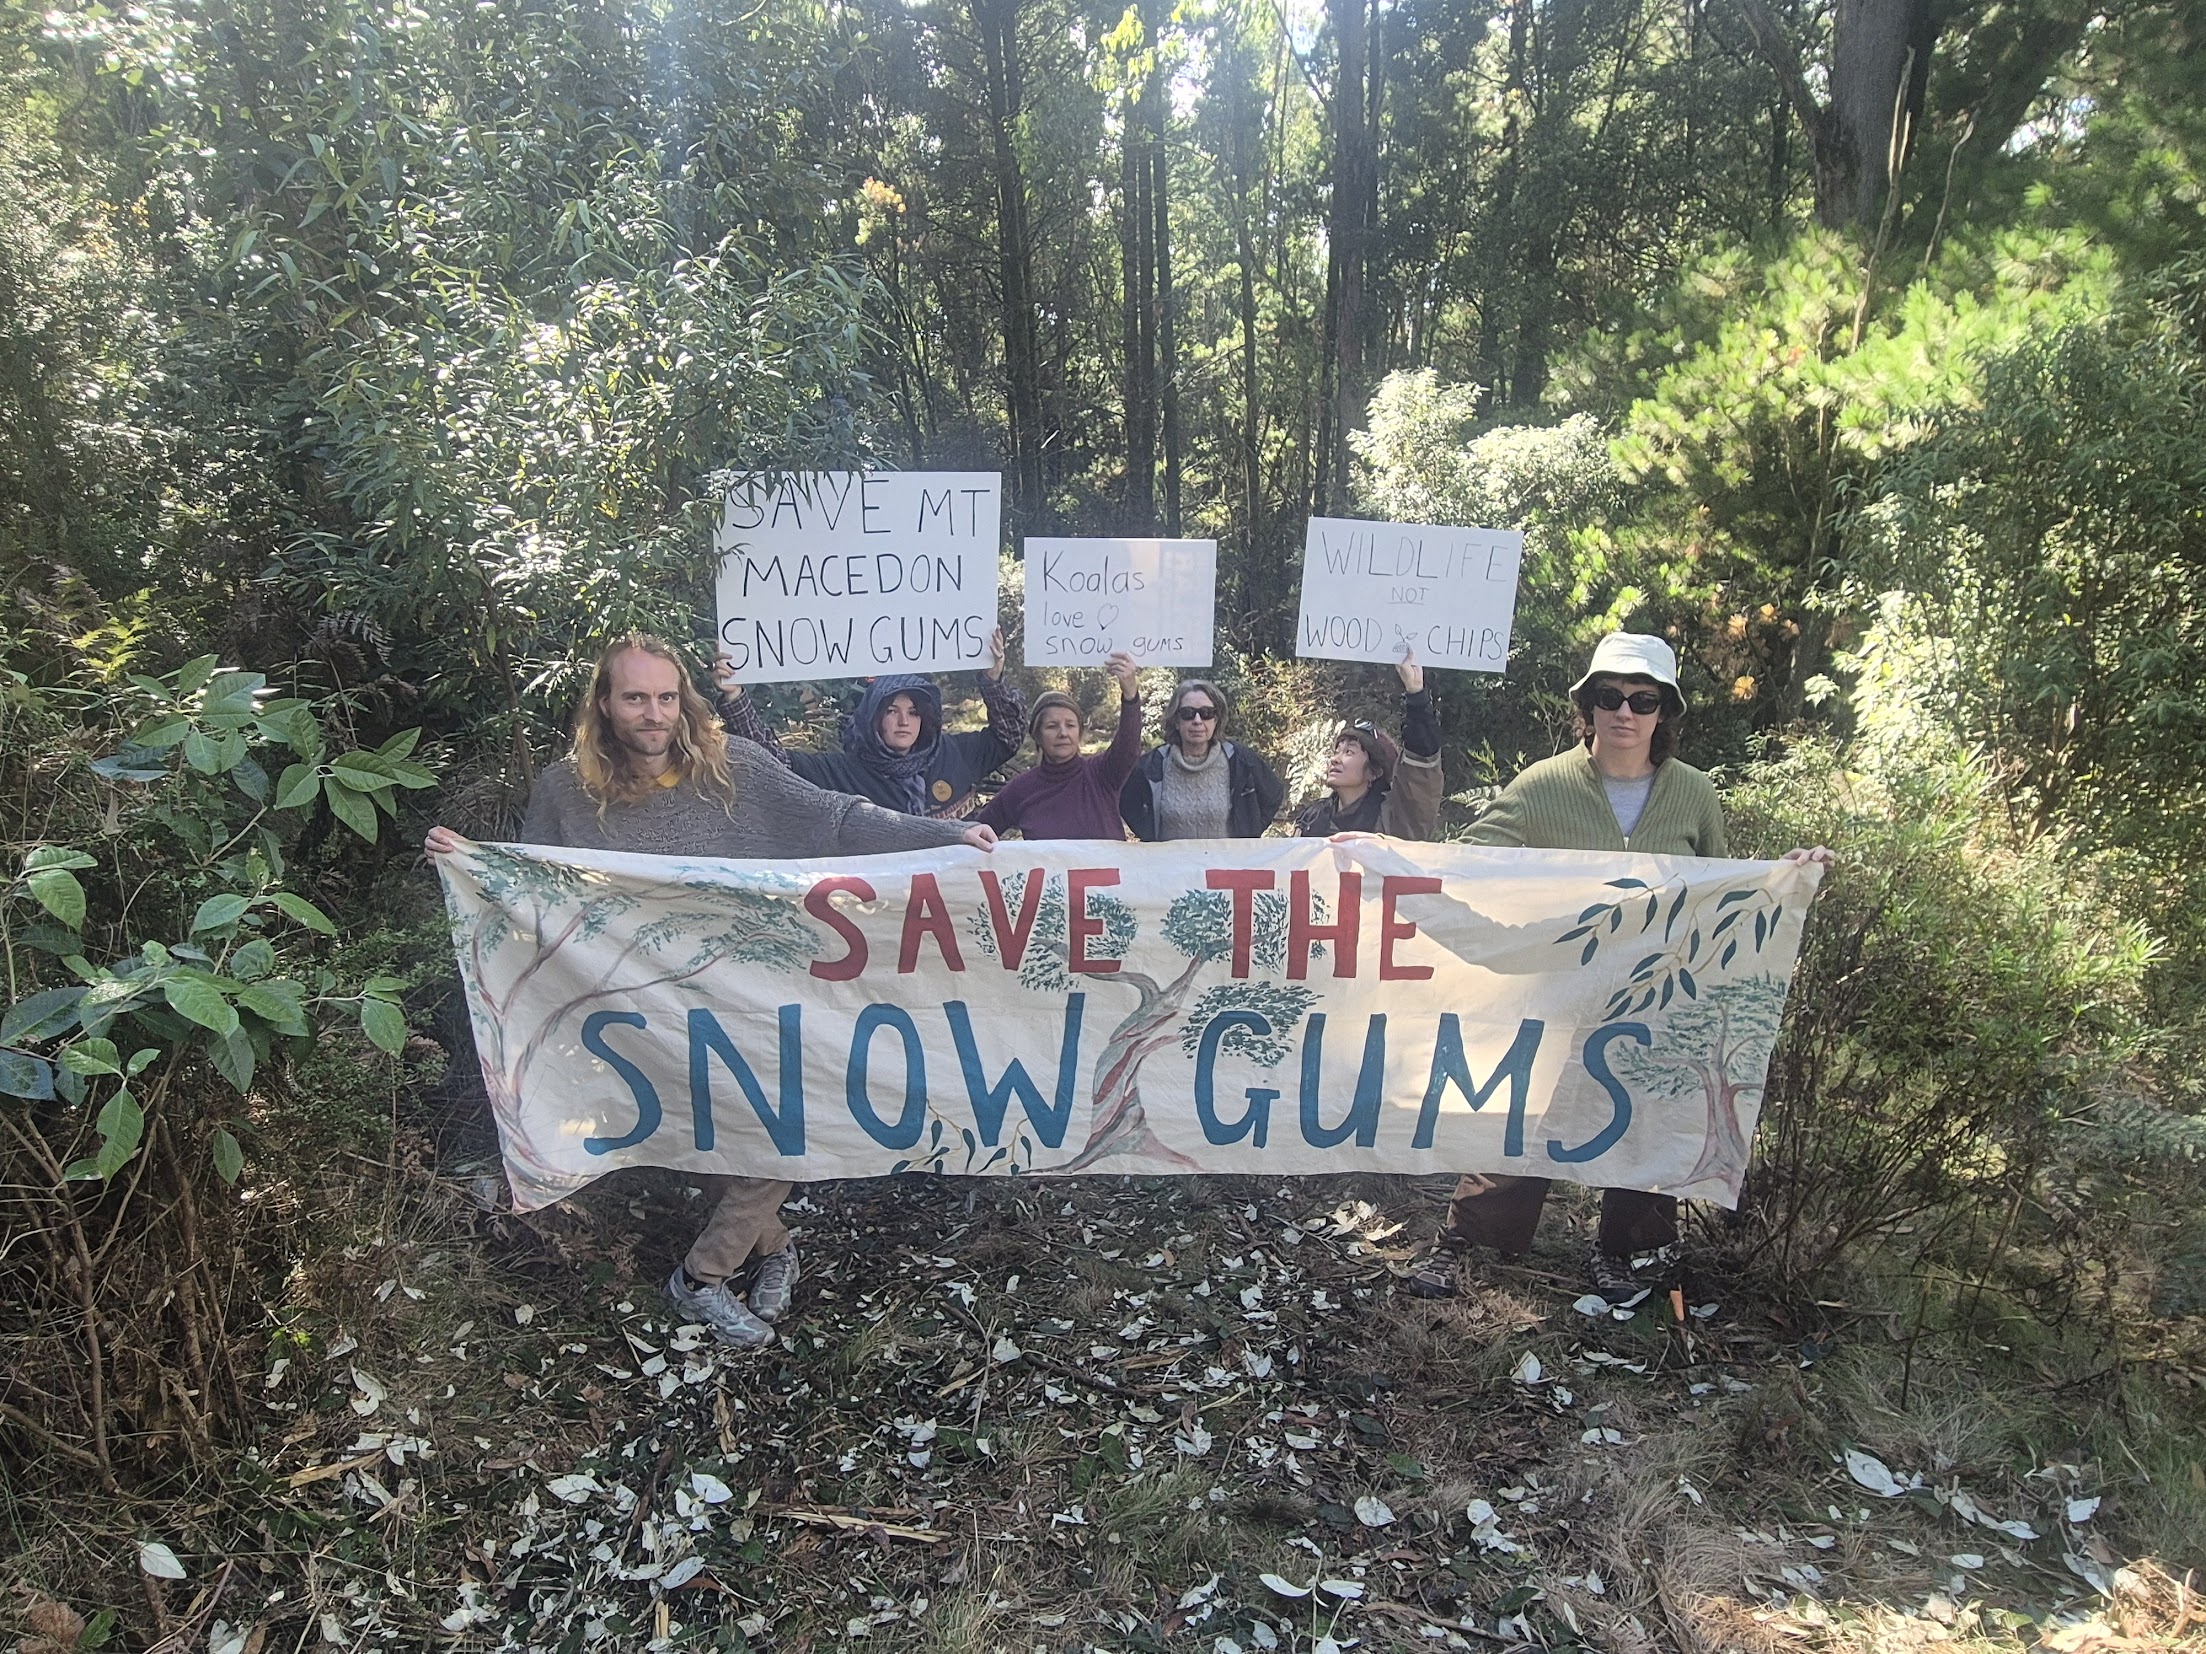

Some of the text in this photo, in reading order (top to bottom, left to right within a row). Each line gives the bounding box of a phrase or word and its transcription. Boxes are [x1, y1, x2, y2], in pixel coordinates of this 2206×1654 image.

[730, 475, 991, 538] SAVE MT
[743, 553, 962, 598] MACEDON
[1043, 550, 1145, 596] Koalas
[1321, 531, 1509, 582] WILDLIFE
[1043, 601, 1085, 629] love
[1391, 586, 1431, 603] NOT
[721, 615, 984, 670] SNOW GUMS
[1045, 635, 1113, 655] snow
[1306, 614, 1505, 660] WOOD CHIPS
[803, 867, 1442, 981] SAVE THE
[581, 992, 1652, 1163] SNOW GUMS
